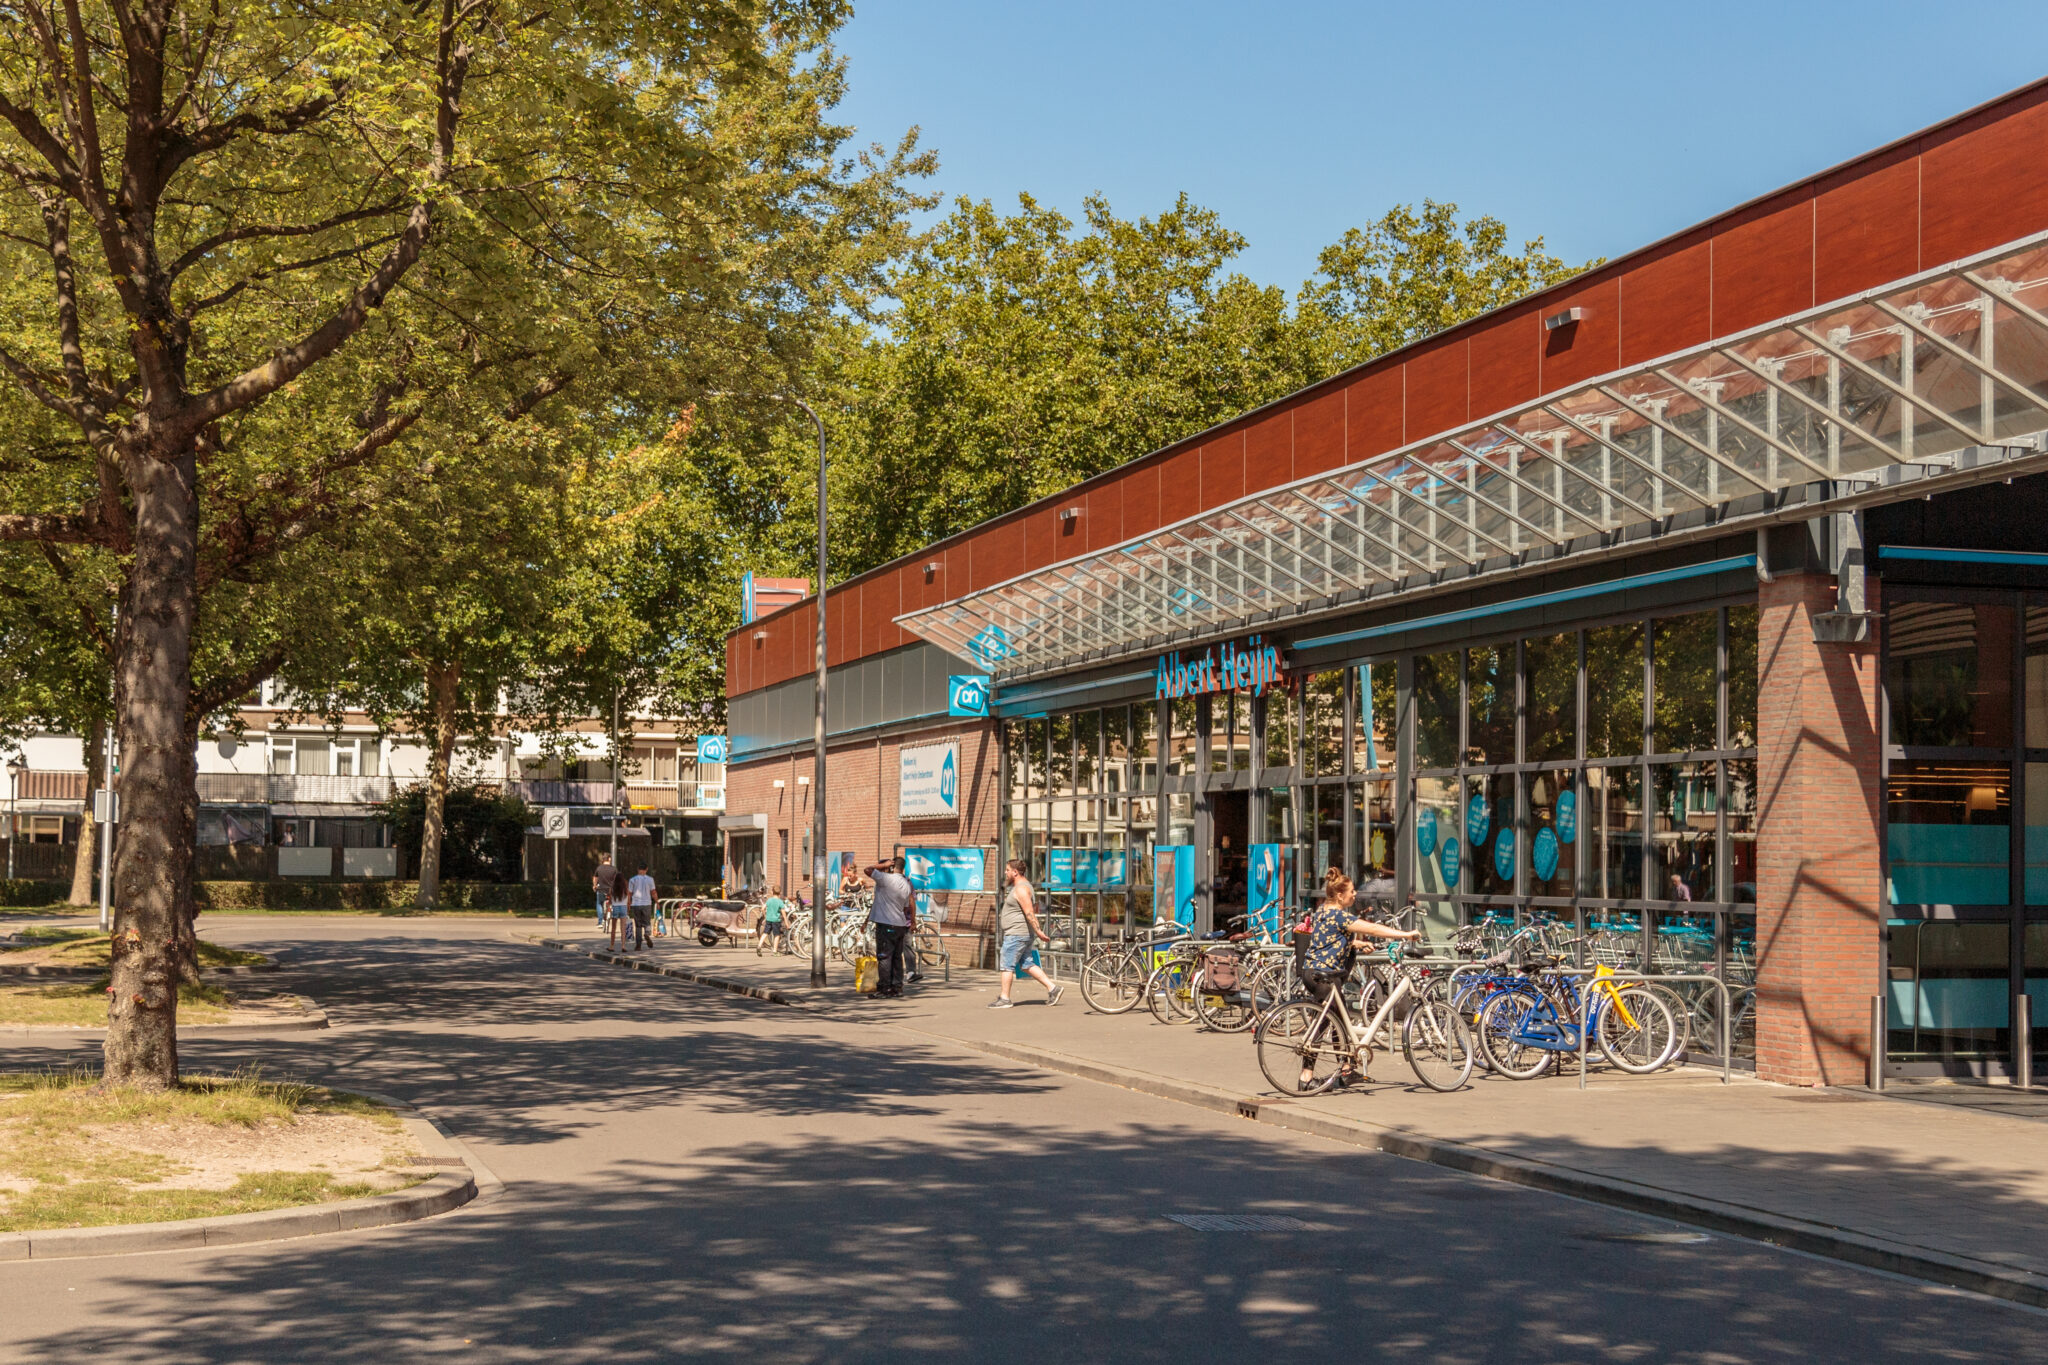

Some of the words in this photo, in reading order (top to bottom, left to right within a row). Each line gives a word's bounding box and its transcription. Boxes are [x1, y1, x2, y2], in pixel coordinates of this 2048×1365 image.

[1156, 648, 1215, 700] Albert
[1221, 635, 1277, 698] Heijn
[552, 819, 562, 827] 30
